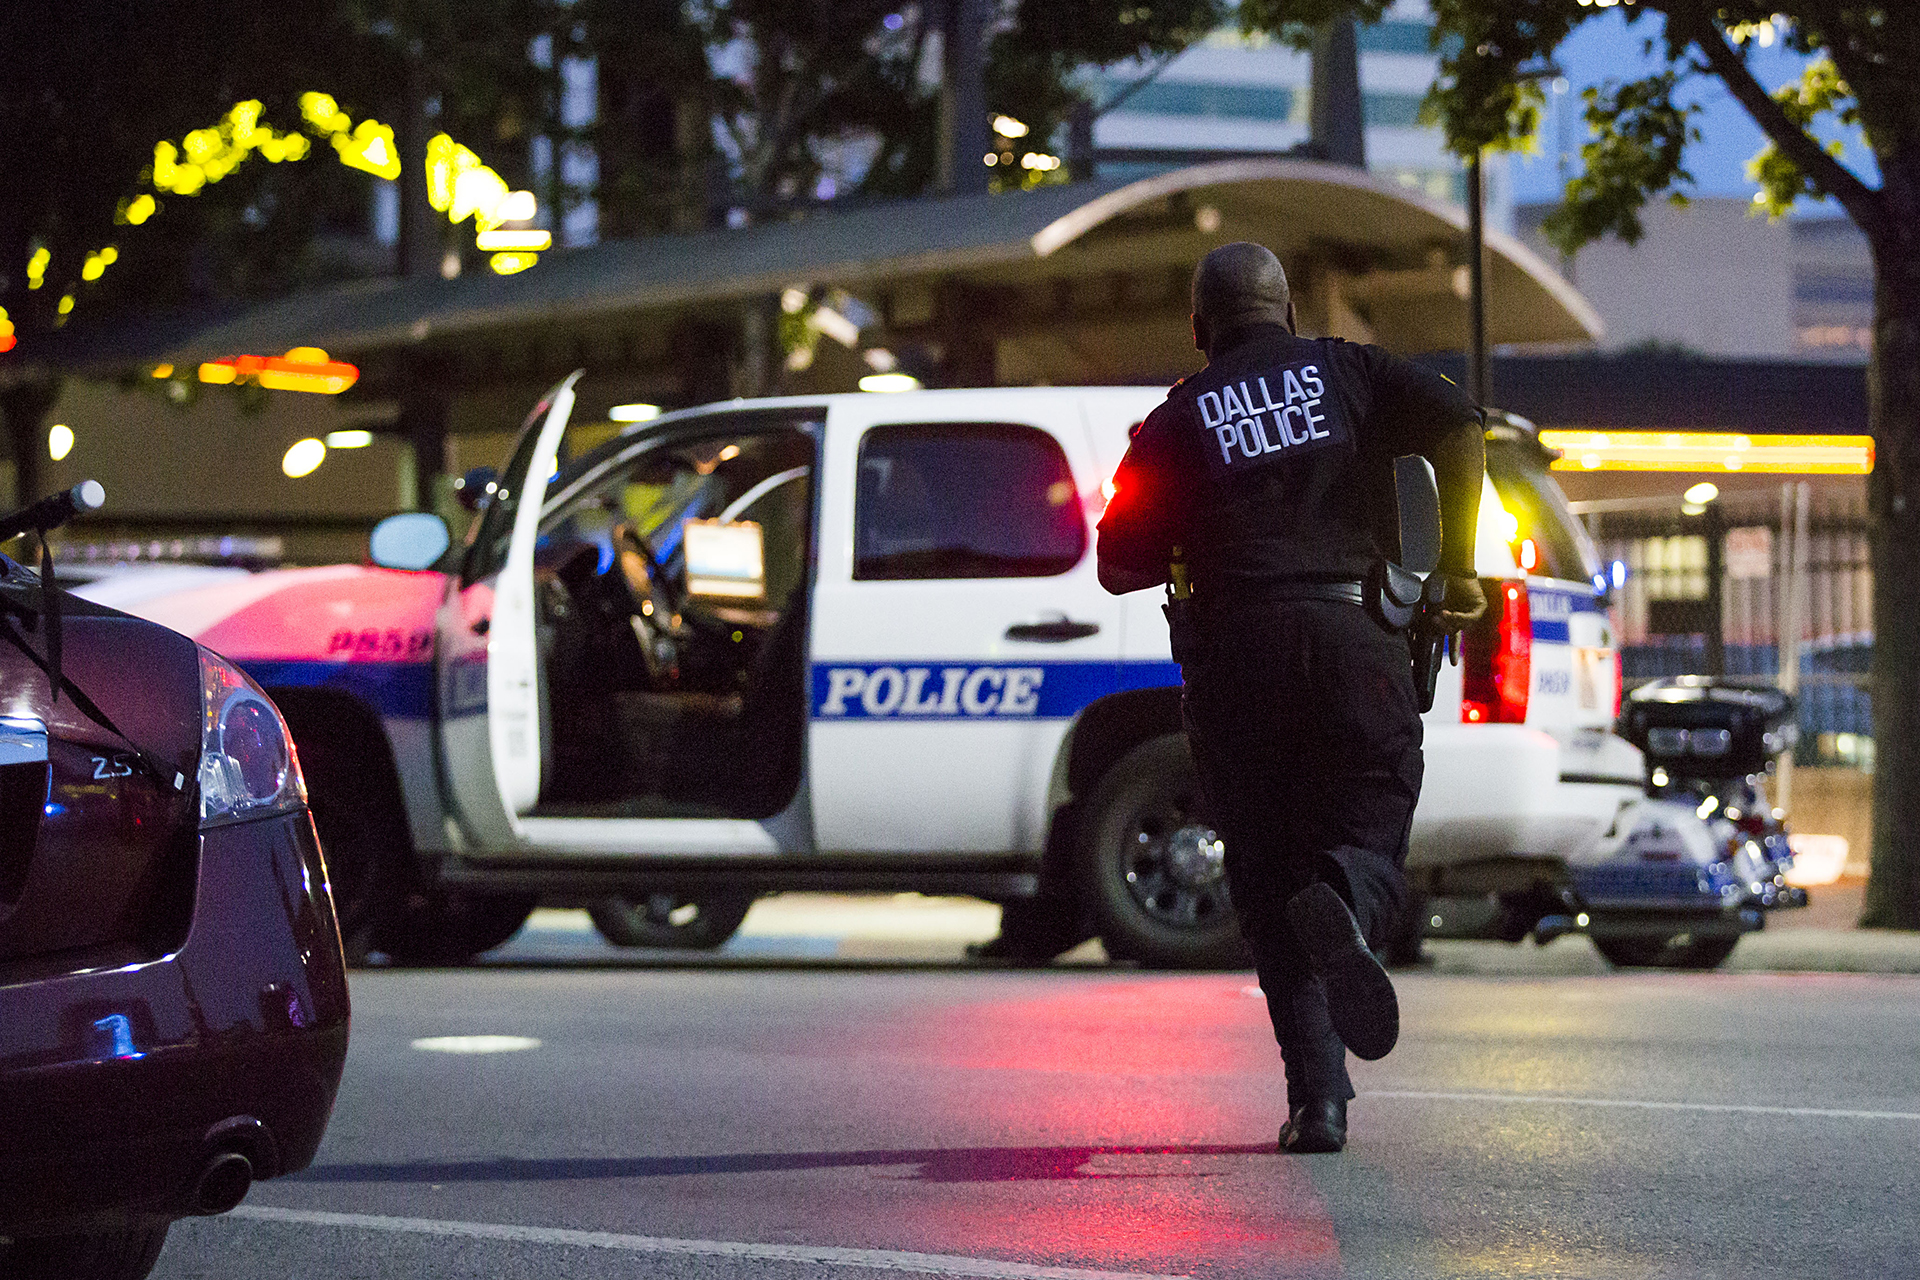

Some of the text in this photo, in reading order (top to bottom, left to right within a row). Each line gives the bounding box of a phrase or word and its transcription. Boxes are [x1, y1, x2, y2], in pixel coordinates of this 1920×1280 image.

[1197, 365, 1325, 429] DALLAS
[1215, 399, 1330, 465] POLICE
[819, 667, 1044, 715] POLICE
